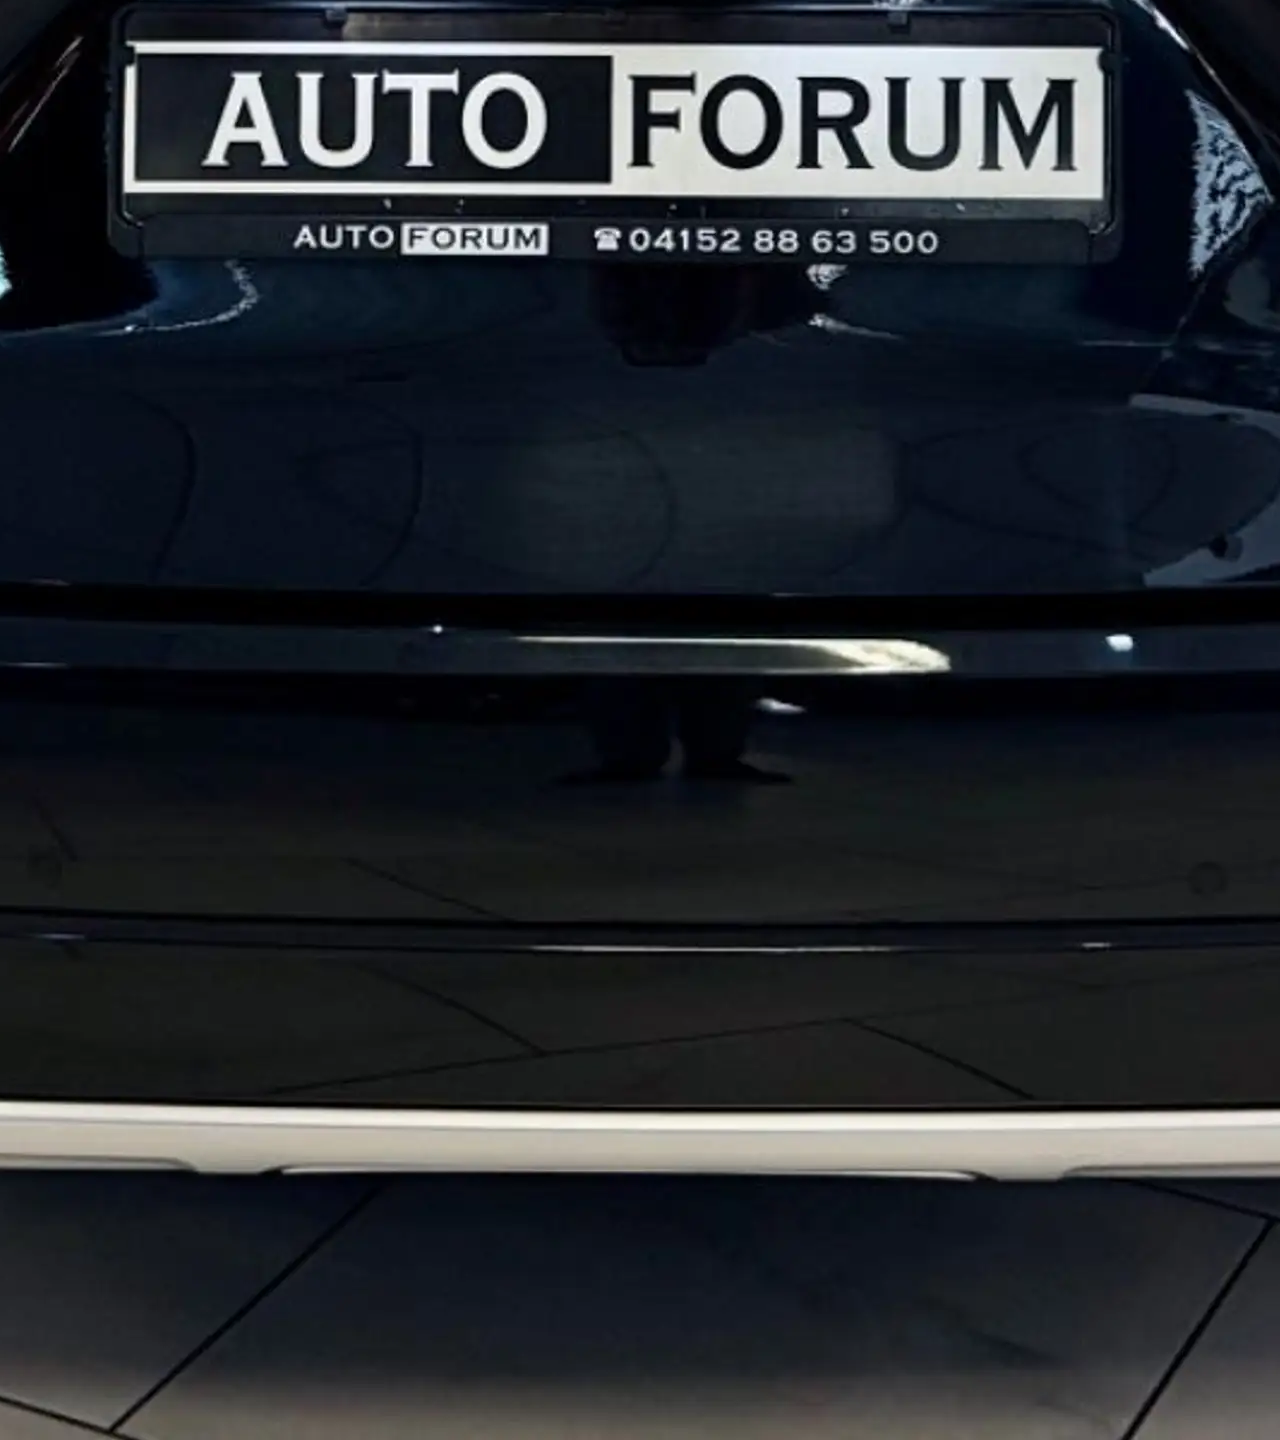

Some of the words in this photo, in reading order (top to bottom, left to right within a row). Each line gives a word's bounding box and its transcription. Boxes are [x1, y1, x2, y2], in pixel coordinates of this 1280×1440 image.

[202, 69, 548, 169] AUTO
[628, 73, 1077, 172] FORUM
[293, 225, 395, 250] AUTO
[408, 226, 543, 251] FORUM
[629, 227, 741, 252] 04152
[753, 229, 799, 253] 88
[811, 230, 856, 254] 63
[870, 230, 938, 254] 500
